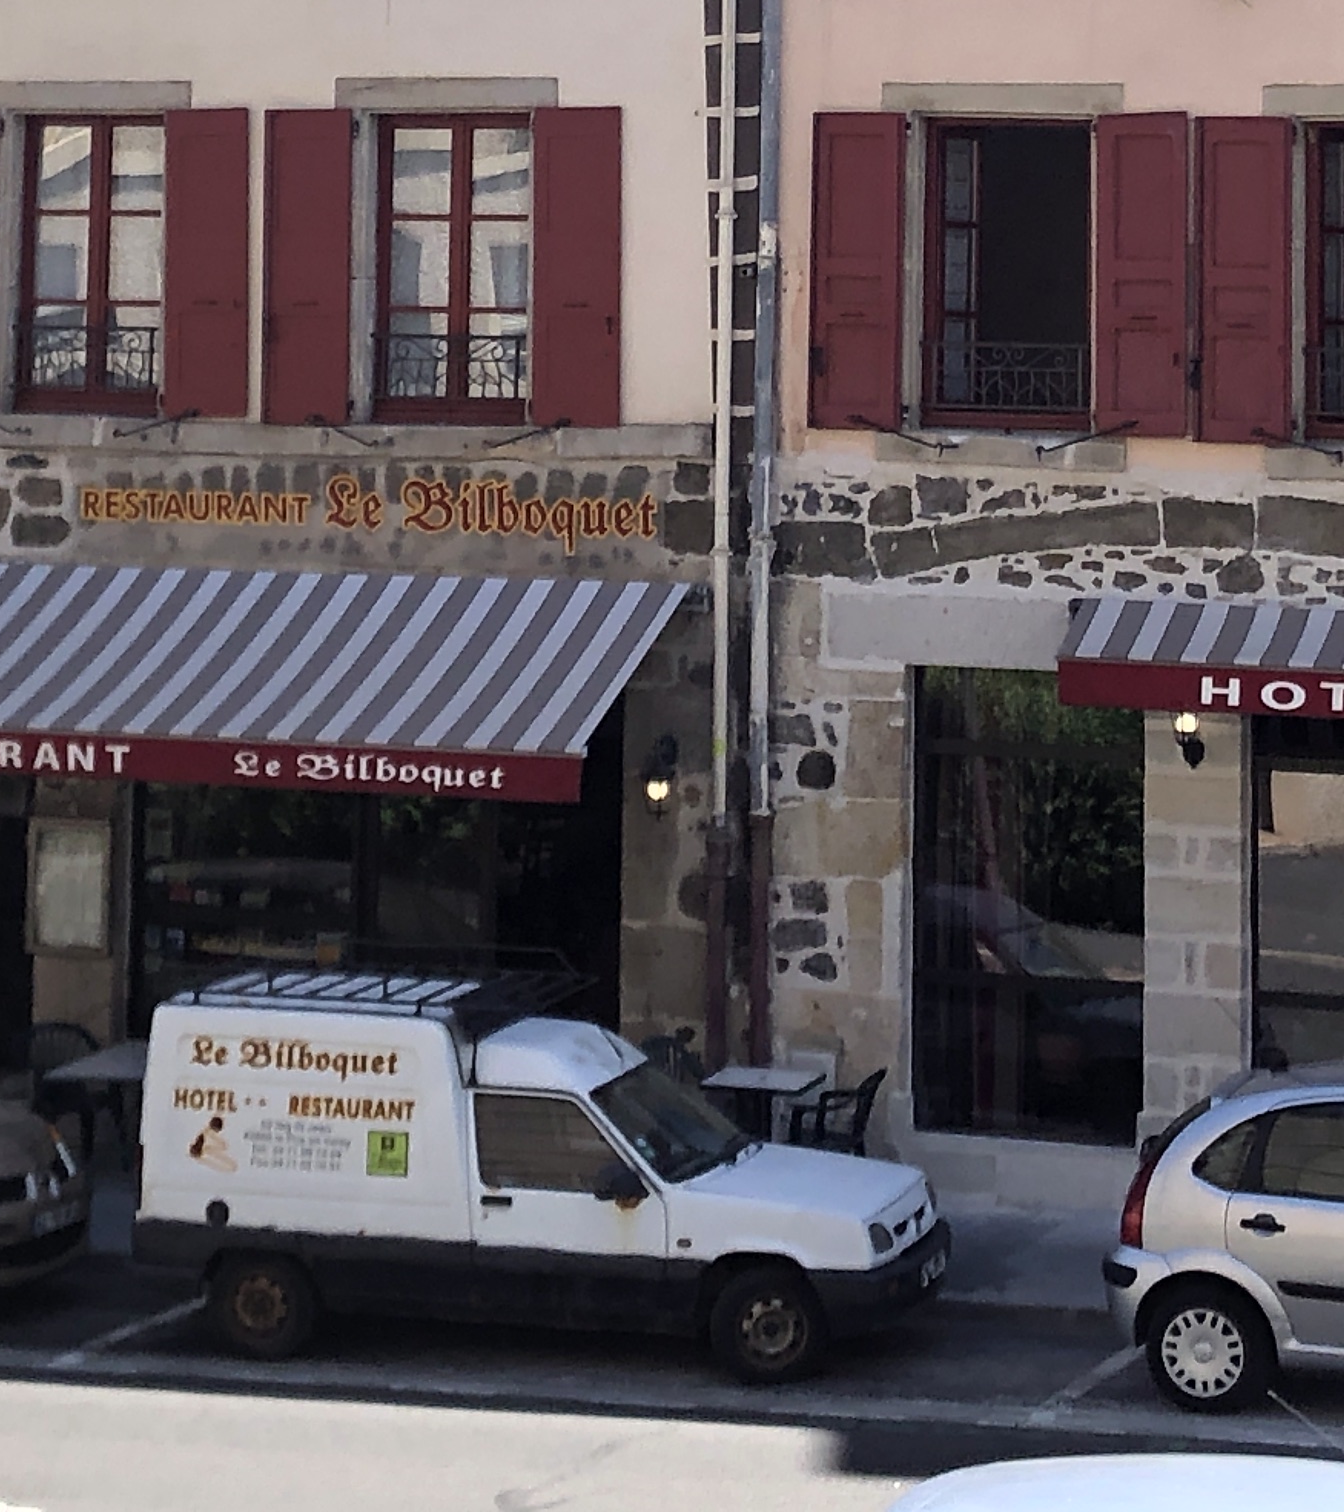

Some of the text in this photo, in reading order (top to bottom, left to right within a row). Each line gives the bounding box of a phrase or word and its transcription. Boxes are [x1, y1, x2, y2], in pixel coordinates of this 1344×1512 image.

[81, 474, 658, 555] RESTAURANT Le Bilboquet
[233, 750, 282, 777] Le
[296, 753, 505, 792] Bilboquet
[189, 1034, 398, 1083] Le Bilboquet
[173, 1088, 417, 1122] HOTEL RESTAURANT
